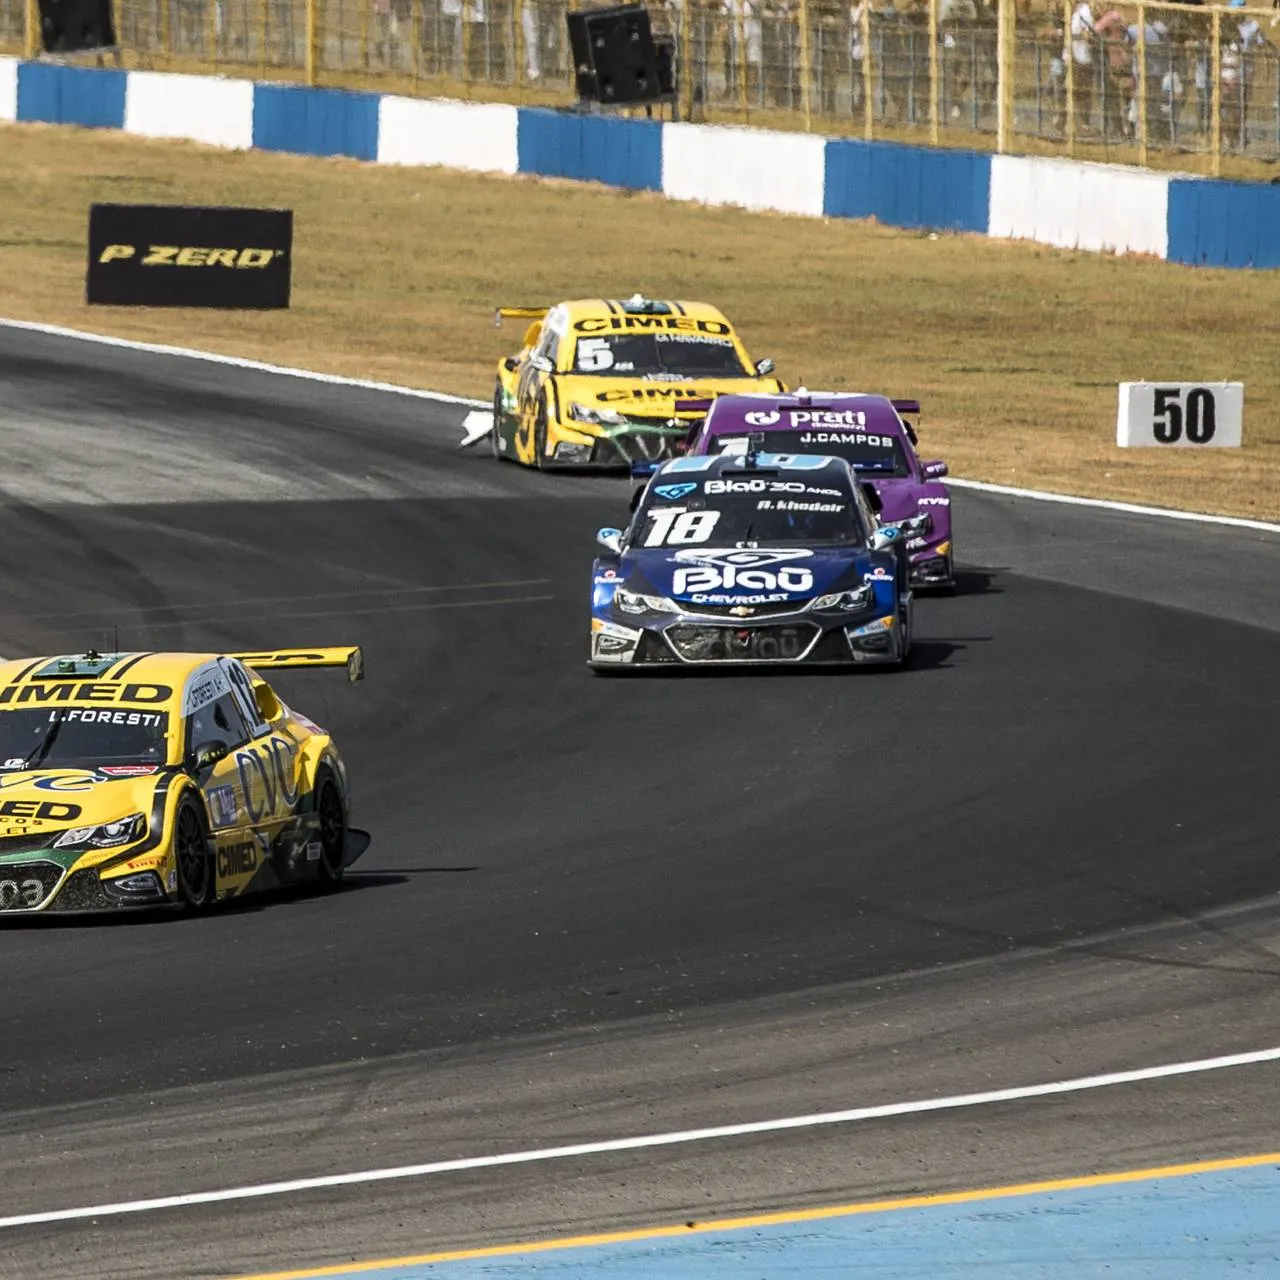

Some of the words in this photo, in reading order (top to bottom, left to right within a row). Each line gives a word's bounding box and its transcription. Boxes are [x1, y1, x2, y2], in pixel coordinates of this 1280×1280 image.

[98, 245, 136, 263] P
[143, 245, 275, 268] ZERO
[574, 317, 730, 335] CIMED
[577, 338, 614, 371] 5
[790, 410, 866, 427] prati
[1153, 387, 1216, 444] 50
[800, 433, 893, 447] J.CAMPOS
[644, 508, 721, 547] 18
[692, 593, 789, 604] CHEVROLET
[49, 710, 161, 727] L.FORESTI
[218, 840, 257, 878] CIMED
